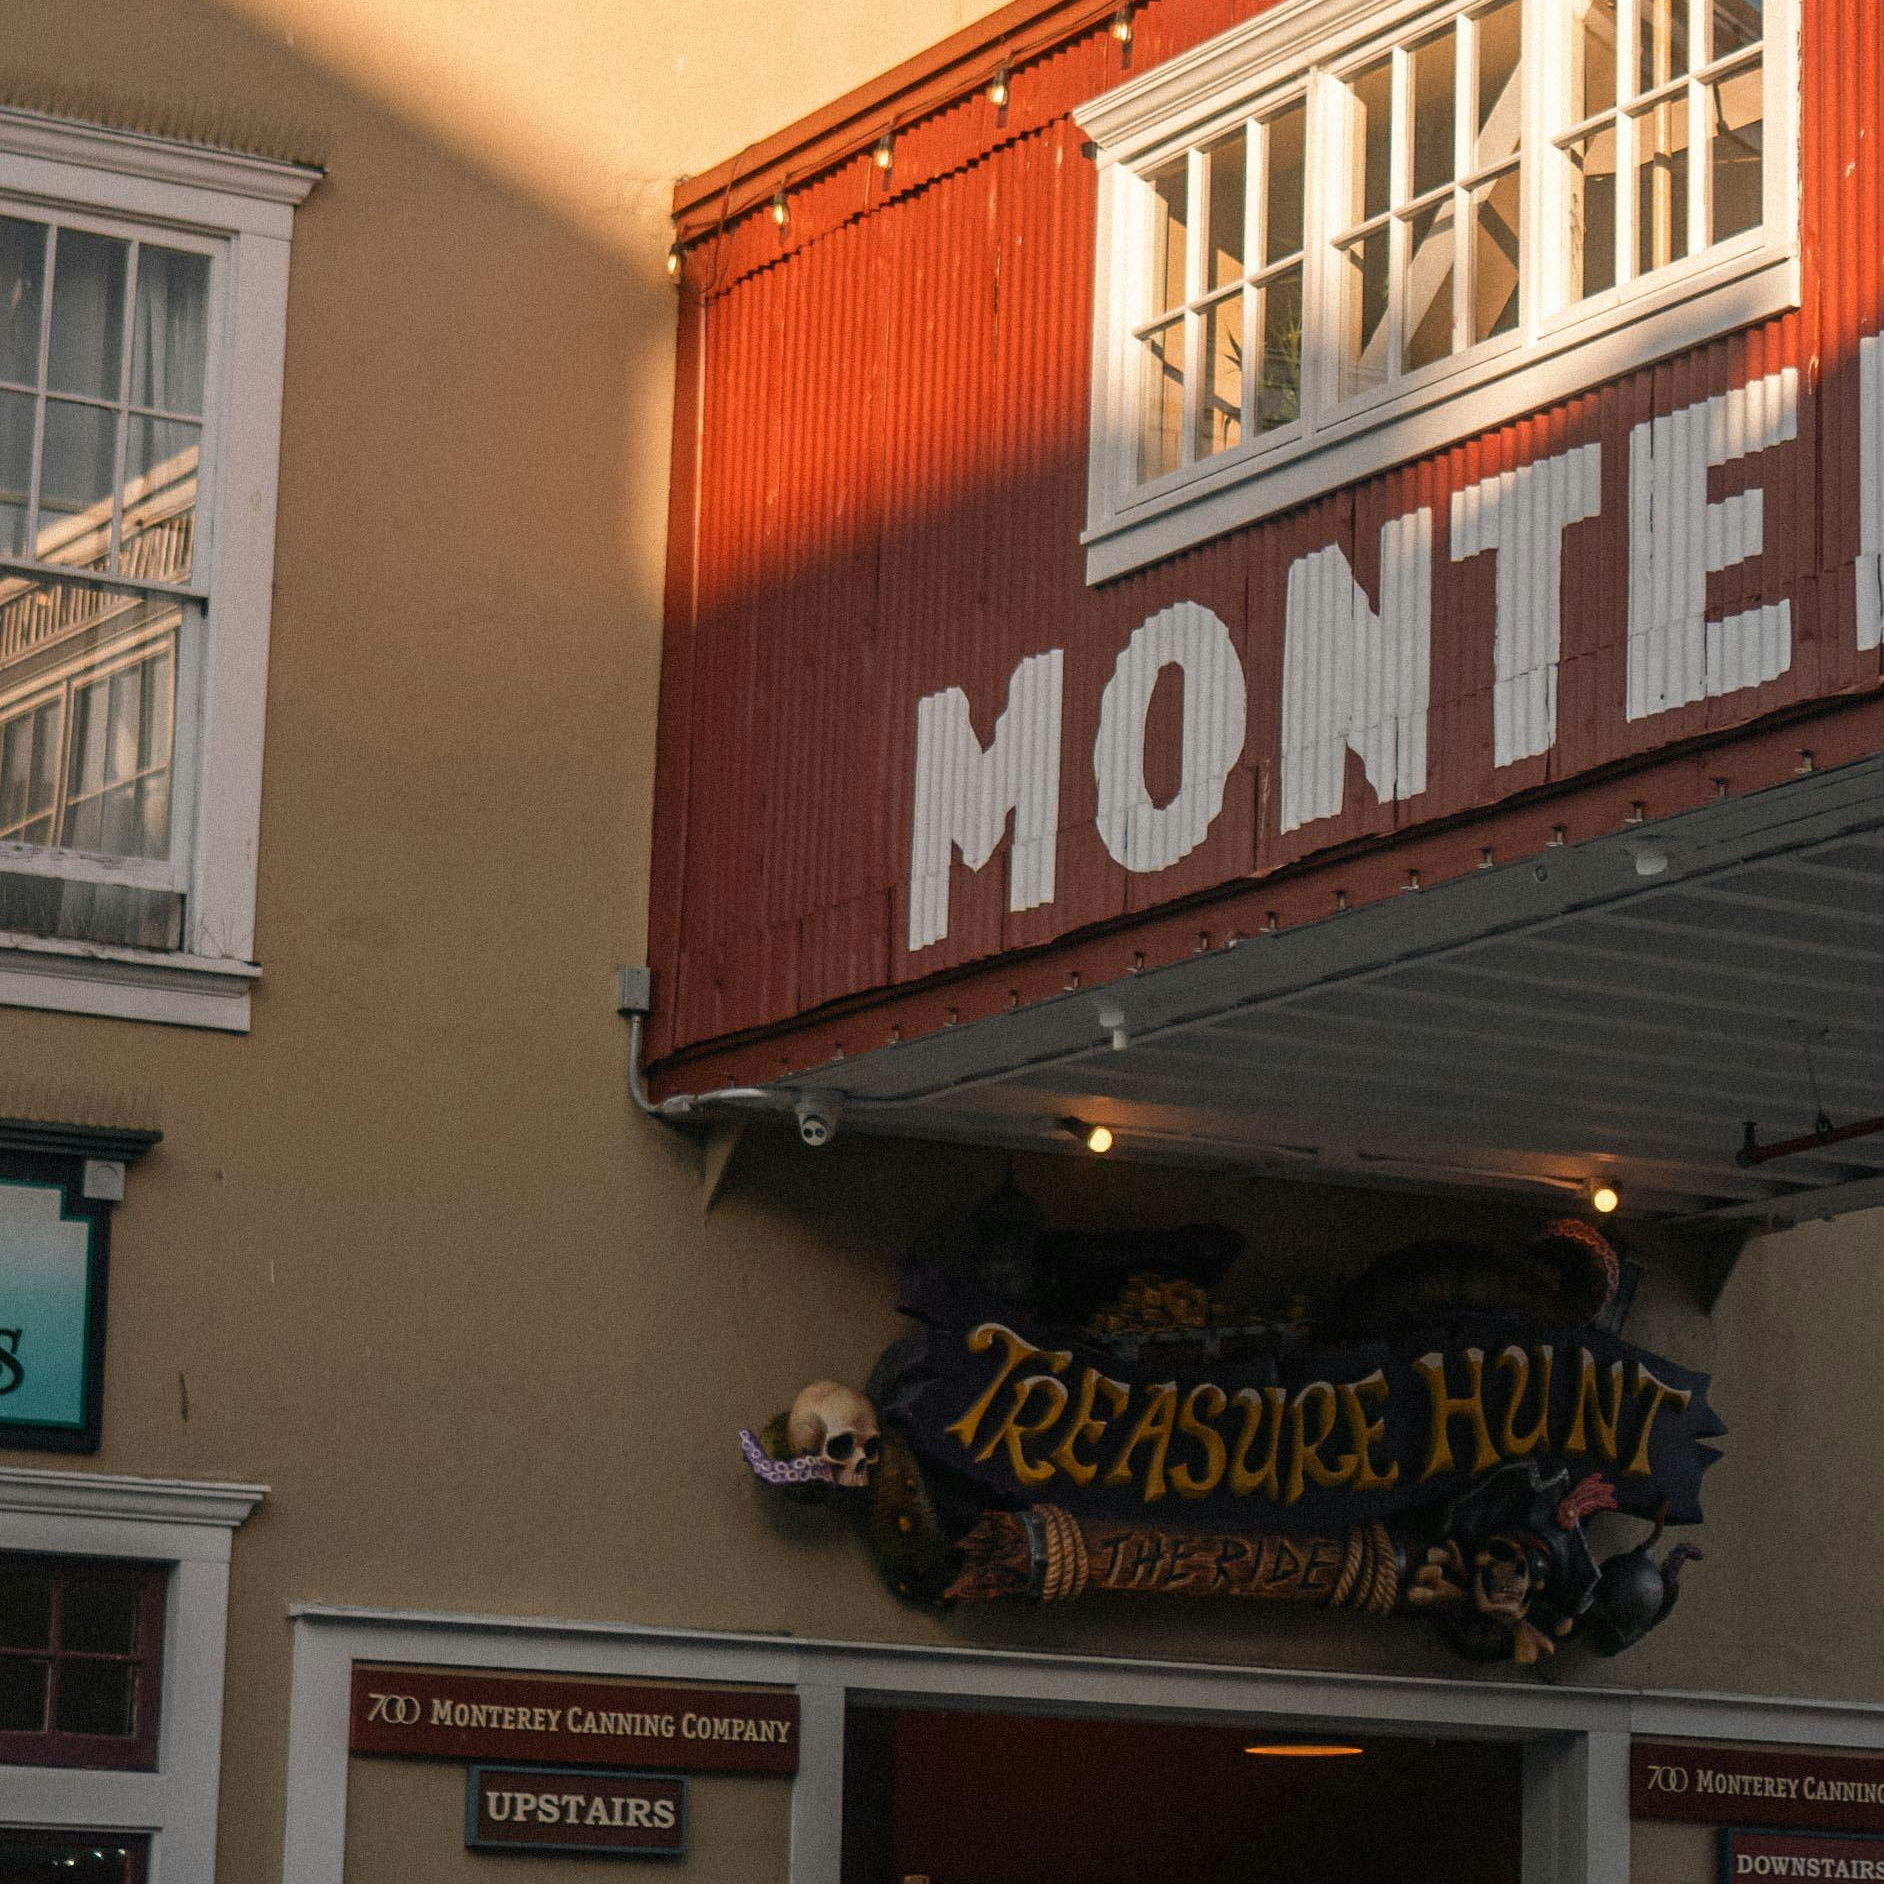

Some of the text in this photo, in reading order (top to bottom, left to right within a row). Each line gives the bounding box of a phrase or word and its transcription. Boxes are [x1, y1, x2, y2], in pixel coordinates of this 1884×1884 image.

[944, 1321, 1692, 1506] TREASURE HUNT
[1102, 1531, 1336, 1594] THE RIDE
[367, 1692, 791, 1745] 700 MONTEREY CANNING COMPANY
[1647, 1764, 1690, 1793] 700
[1696, 1769, 1800, 1800] MONTEREY
[485, 1790, 676, 1830] UPSTAIRS
